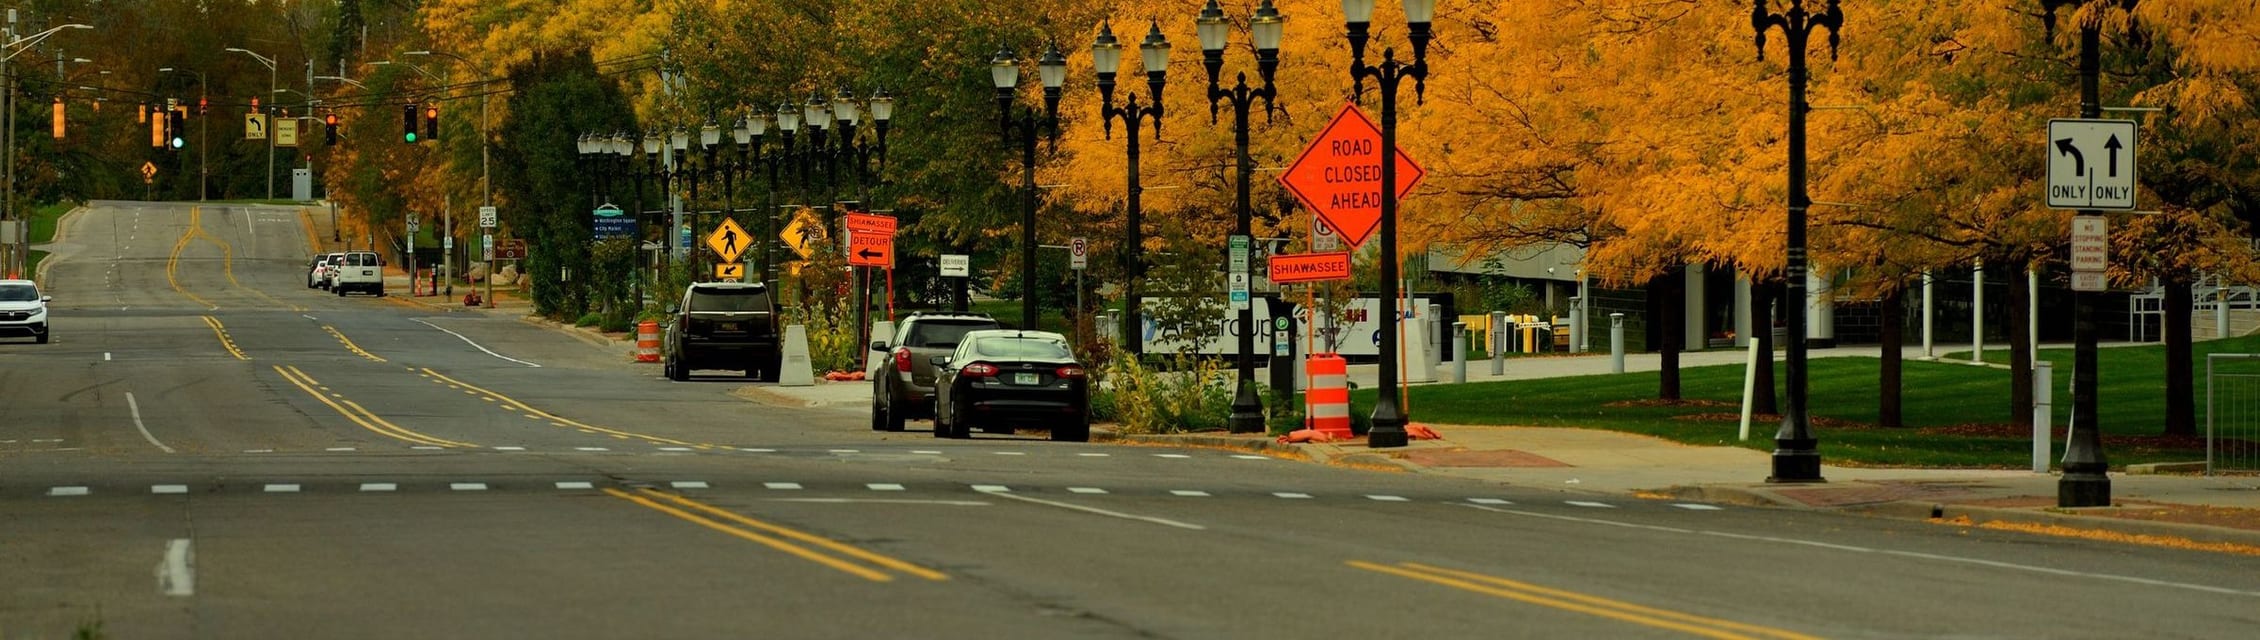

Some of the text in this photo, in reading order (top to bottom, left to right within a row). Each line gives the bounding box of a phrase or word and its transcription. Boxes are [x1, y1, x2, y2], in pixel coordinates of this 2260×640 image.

[1332, 139, 1372, 156] ROAD
[1325, 165, 1382, 183] CLOSED
[2052, 185, 2085, 198] ONLY
[2096, 186, 2129, 199] ONLY
[1331, 192, 1381, 209] AHEAD
[481, 217, 495, 225] 25
[853, 237, 888, 246] DETOUR
[1274, 262, 1345, 275] SHIAWASSEE
